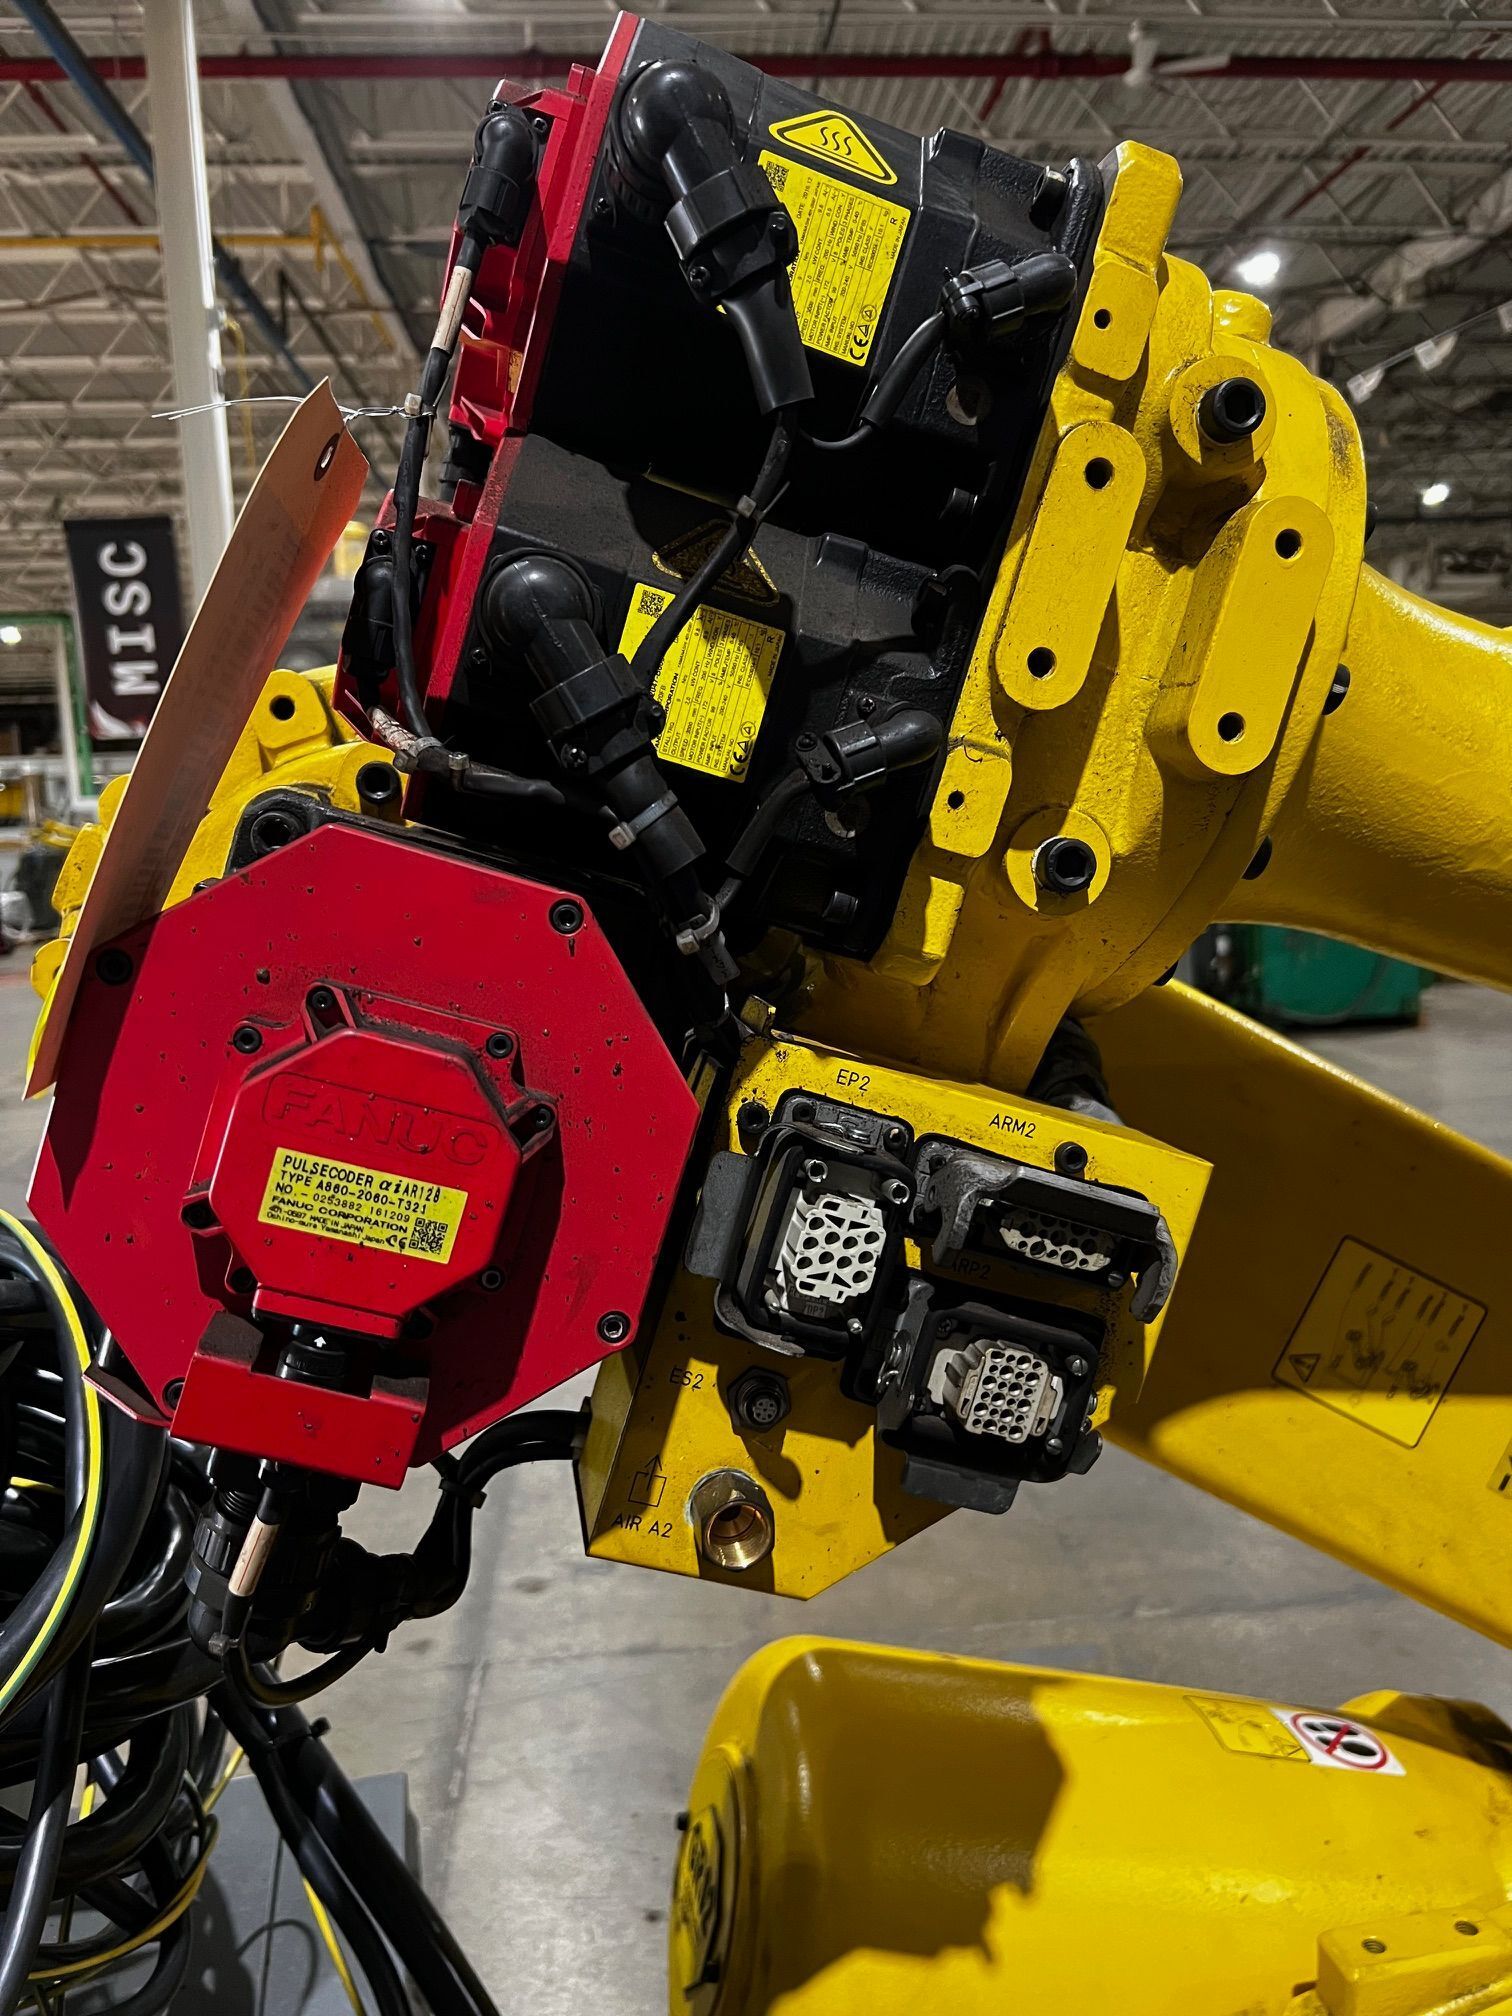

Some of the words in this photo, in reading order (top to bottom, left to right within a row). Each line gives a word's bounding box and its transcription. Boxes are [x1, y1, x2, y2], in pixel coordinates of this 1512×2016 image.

[796, 202, 804, 219] DATE
[889, 216, 897, 225] R
[829, 219, 837, 235] WIND
[896, 215, 906, 236] JAPAN
[814, 237, 823, 255] CONT
[889, 242, 898, 260] MADE
[894, 235, 900, 243] IN
[807, 319, 818, 341] MOTOR
[835, 227, 845, 247] POLES
[843, 196, 854, 220] PHASES
[836, 315, 846, 339] SYSTEM
[862, 234, 871, 253] CLASS
[829, 315, 837, 333] INPUT
[839, 275, 849, 297] 200-240
[815, 322, 826, 344] POWER
[822, 297, 834, 322] FACTOR
[841, 331, 852, 354] MANUAL
[98, 541, 161, 696] MISC
[765, 634, 775, 643] R
[687, 739, 697, 760] MOTOR
[713, 648, 722, 667] POLES
[720, 618, 731, 642] PHASES
[670, 731, 680, 755] OUTPUT
[692, 660, 700, 676] CONT
[716, 732, 726, 756] SYSTEM
[739, 653, 748, 672] CLASS
[662, 736, 670, 752] STALL
[679, 737, 688, 757] SPEED
[685, 721, 693, 734] 3000
[696, 741, 705, 762] POWER
[702, 717, 712, 741] FACTOR
[708, 733, 717, 751] INPUT
[721, 748, 731, 770] MANUAL
[835, 1067, 872, 1092] EP2
[269, 1089, 488, 1166] FANUC
[988, 1113, 1037, 1139] ARM2
[282, 1154, 374, 1188] PULSECODER
[279, 1169, 312, 1187] TYPE
[315, 1178, 427, 1214] A860-2060-T321
[271, 1194, 313, 1211] FANUC
[318, 1206, 407, 1233] CORPORATION
[312, 1192, 362, 1212] 0253882
[369, 1205, 410, 1223] 161209
[309, 1214, 328, 1224] MADE
[340, 1221, 364, 1233] JAPAN
[320, 1224, 360, 1239] Yamanashi
[361, 1234, 385, 1245] Japan
[669, 1364, 704, 1390] ES2
[611, 1513, 642, 1532] AIR
[648, 1520, 673, 1539] A2
